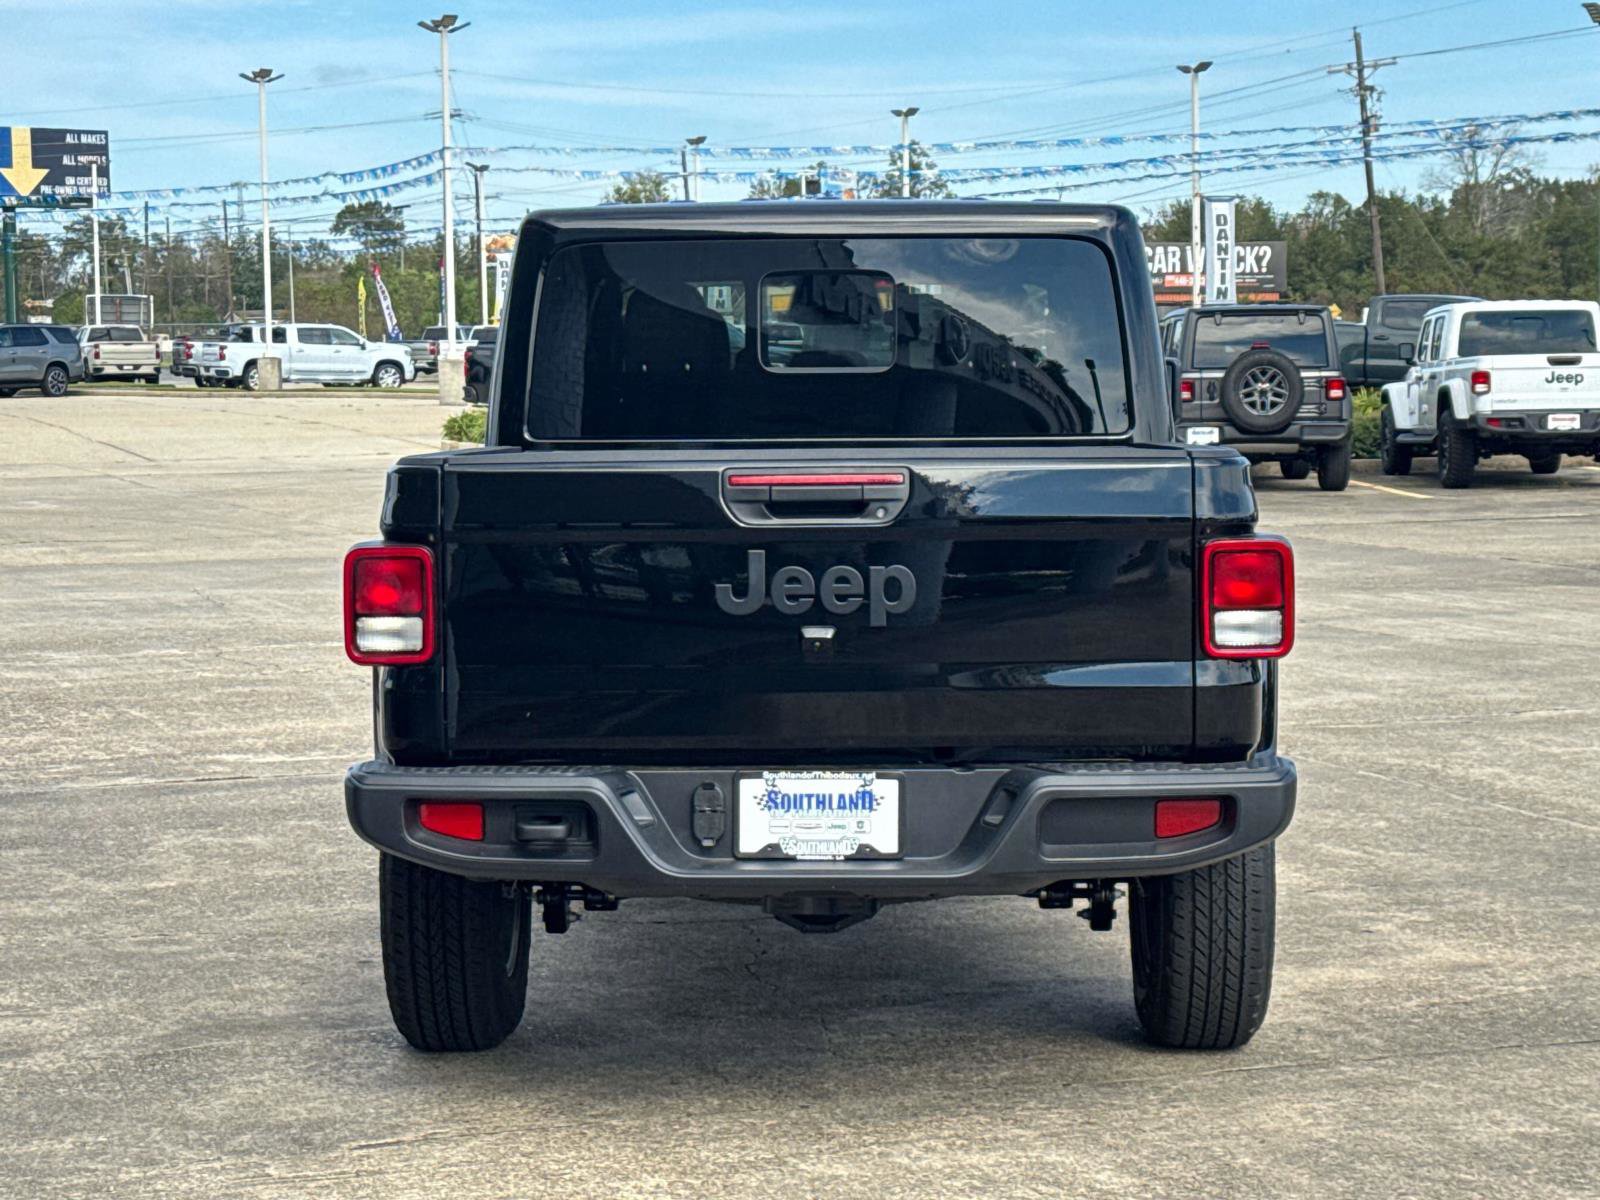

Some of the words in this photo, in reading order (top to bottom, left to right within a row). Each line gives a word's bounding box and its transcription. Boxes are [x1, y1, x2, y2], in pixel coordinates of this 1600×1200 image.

[65, 133, 79, 144] ALL
[80, 133, 106, 144] MAKES
[62, 154, 77, 166] ALL
[1215, 213, 1229, 300] DANTIN
[1545, 371, 1584, 386] Jeep
[715, 549, 917, 627] Jeep
[767, 790, 873, 812] SOUTHLAND
[788, 839, 852, 856] SOUTHLAND
